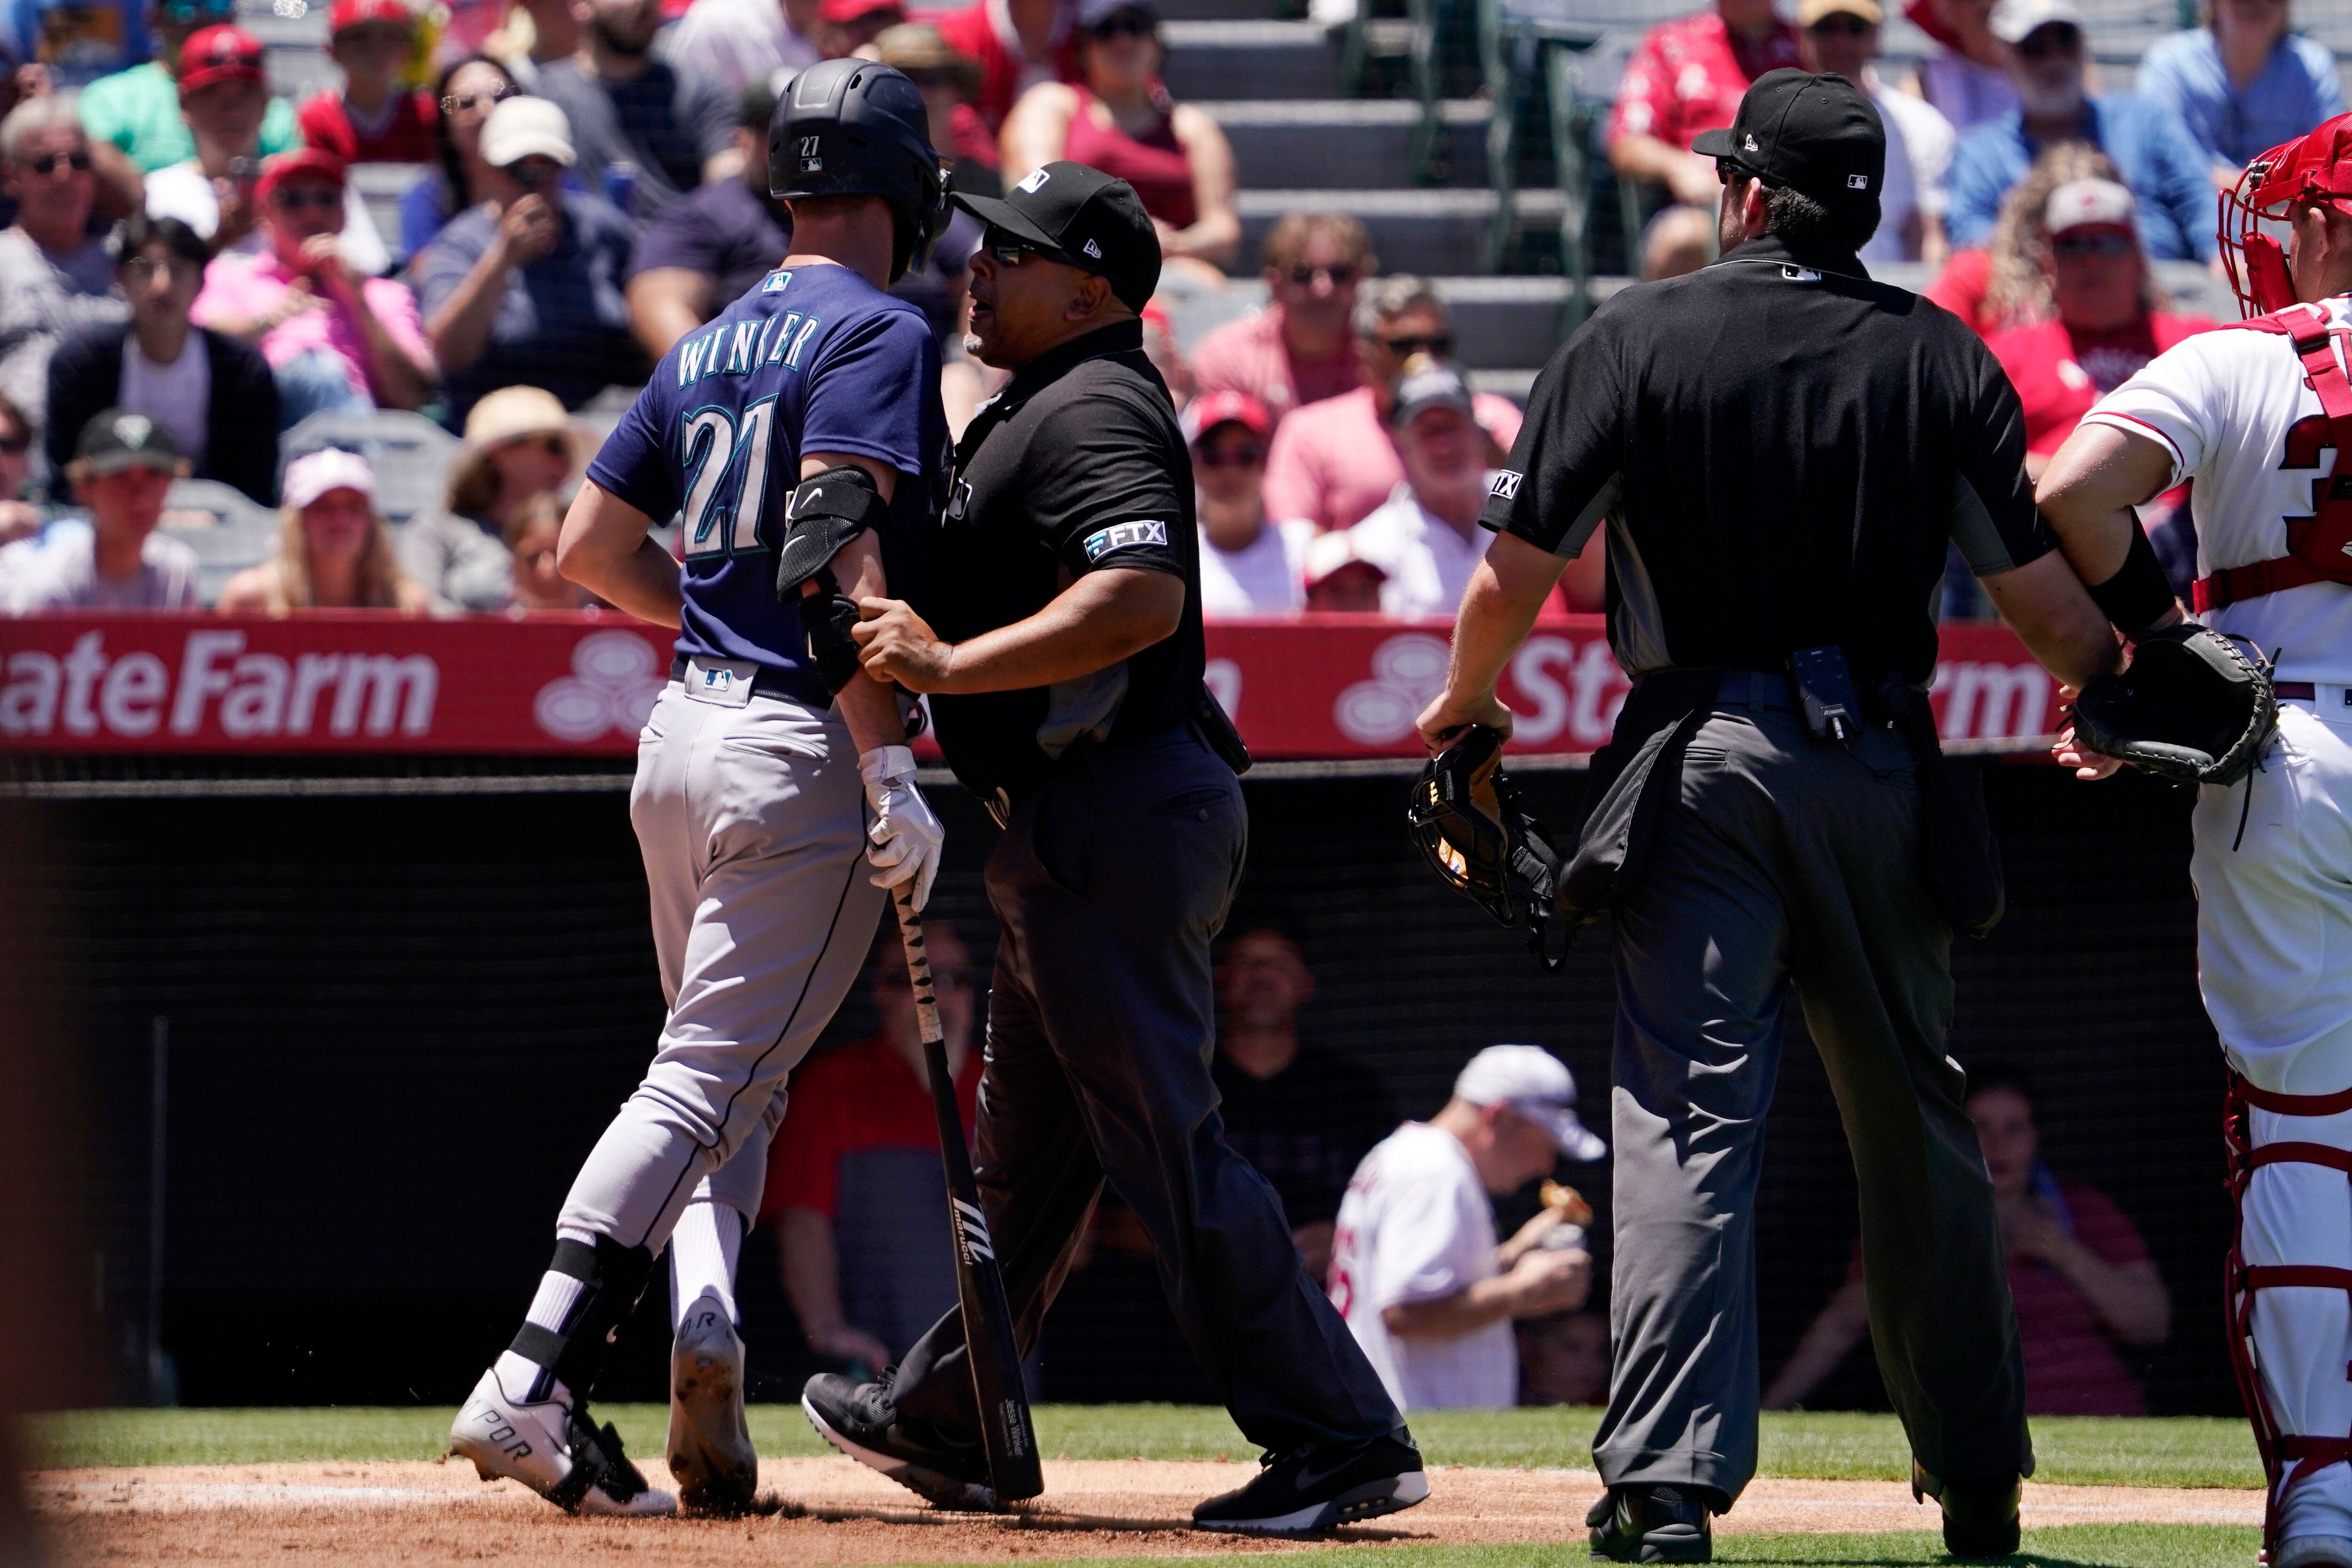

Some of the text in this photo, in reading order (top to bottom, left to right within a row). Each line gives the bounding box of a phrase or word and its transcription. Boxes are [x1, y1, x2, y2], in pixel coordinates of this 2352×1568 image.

[802, 136, 820, 156] 27
[677, 309, 821, 390] WINKER
[682, 392, 779, 562] 21
[1109, 523, 1165, 547] FTX
[954, 1208, 973, 1266] marucci
[1005, 1398, 1017, 1425] Jesse
